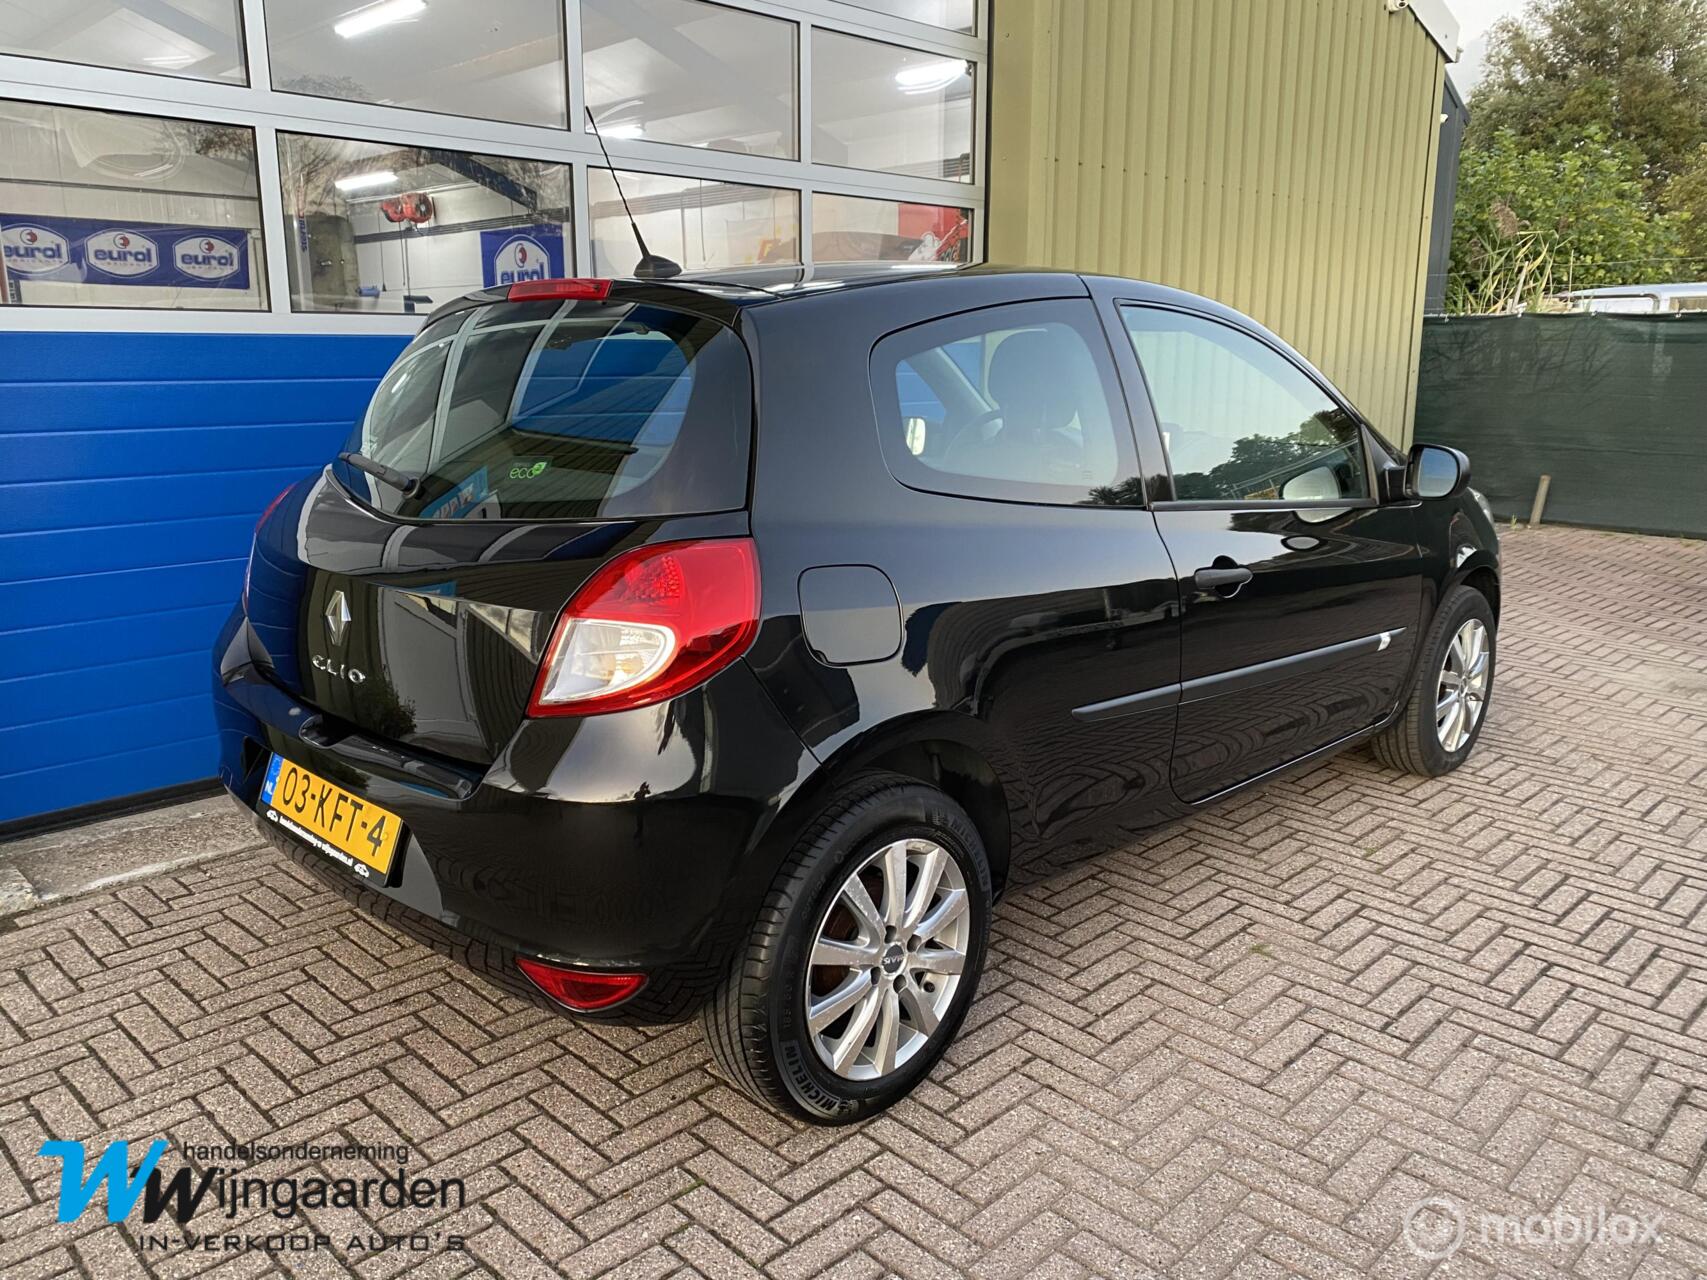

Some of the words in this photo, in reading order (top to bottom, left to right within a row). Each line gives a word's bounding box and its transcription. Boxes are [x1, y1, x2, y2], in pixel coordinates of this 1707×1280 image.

[4, 243, 62, 259] eurol
[94, 248, 152, 262] eurol
[181, 252, 233, 266] eurol
[510, 467, 536, 479] eco
[312, 654, 366, 684] CLIO
[282, 767, 386, 857] 03-KFT-4
[785, 1046, 838, 1111] MICHELIN
